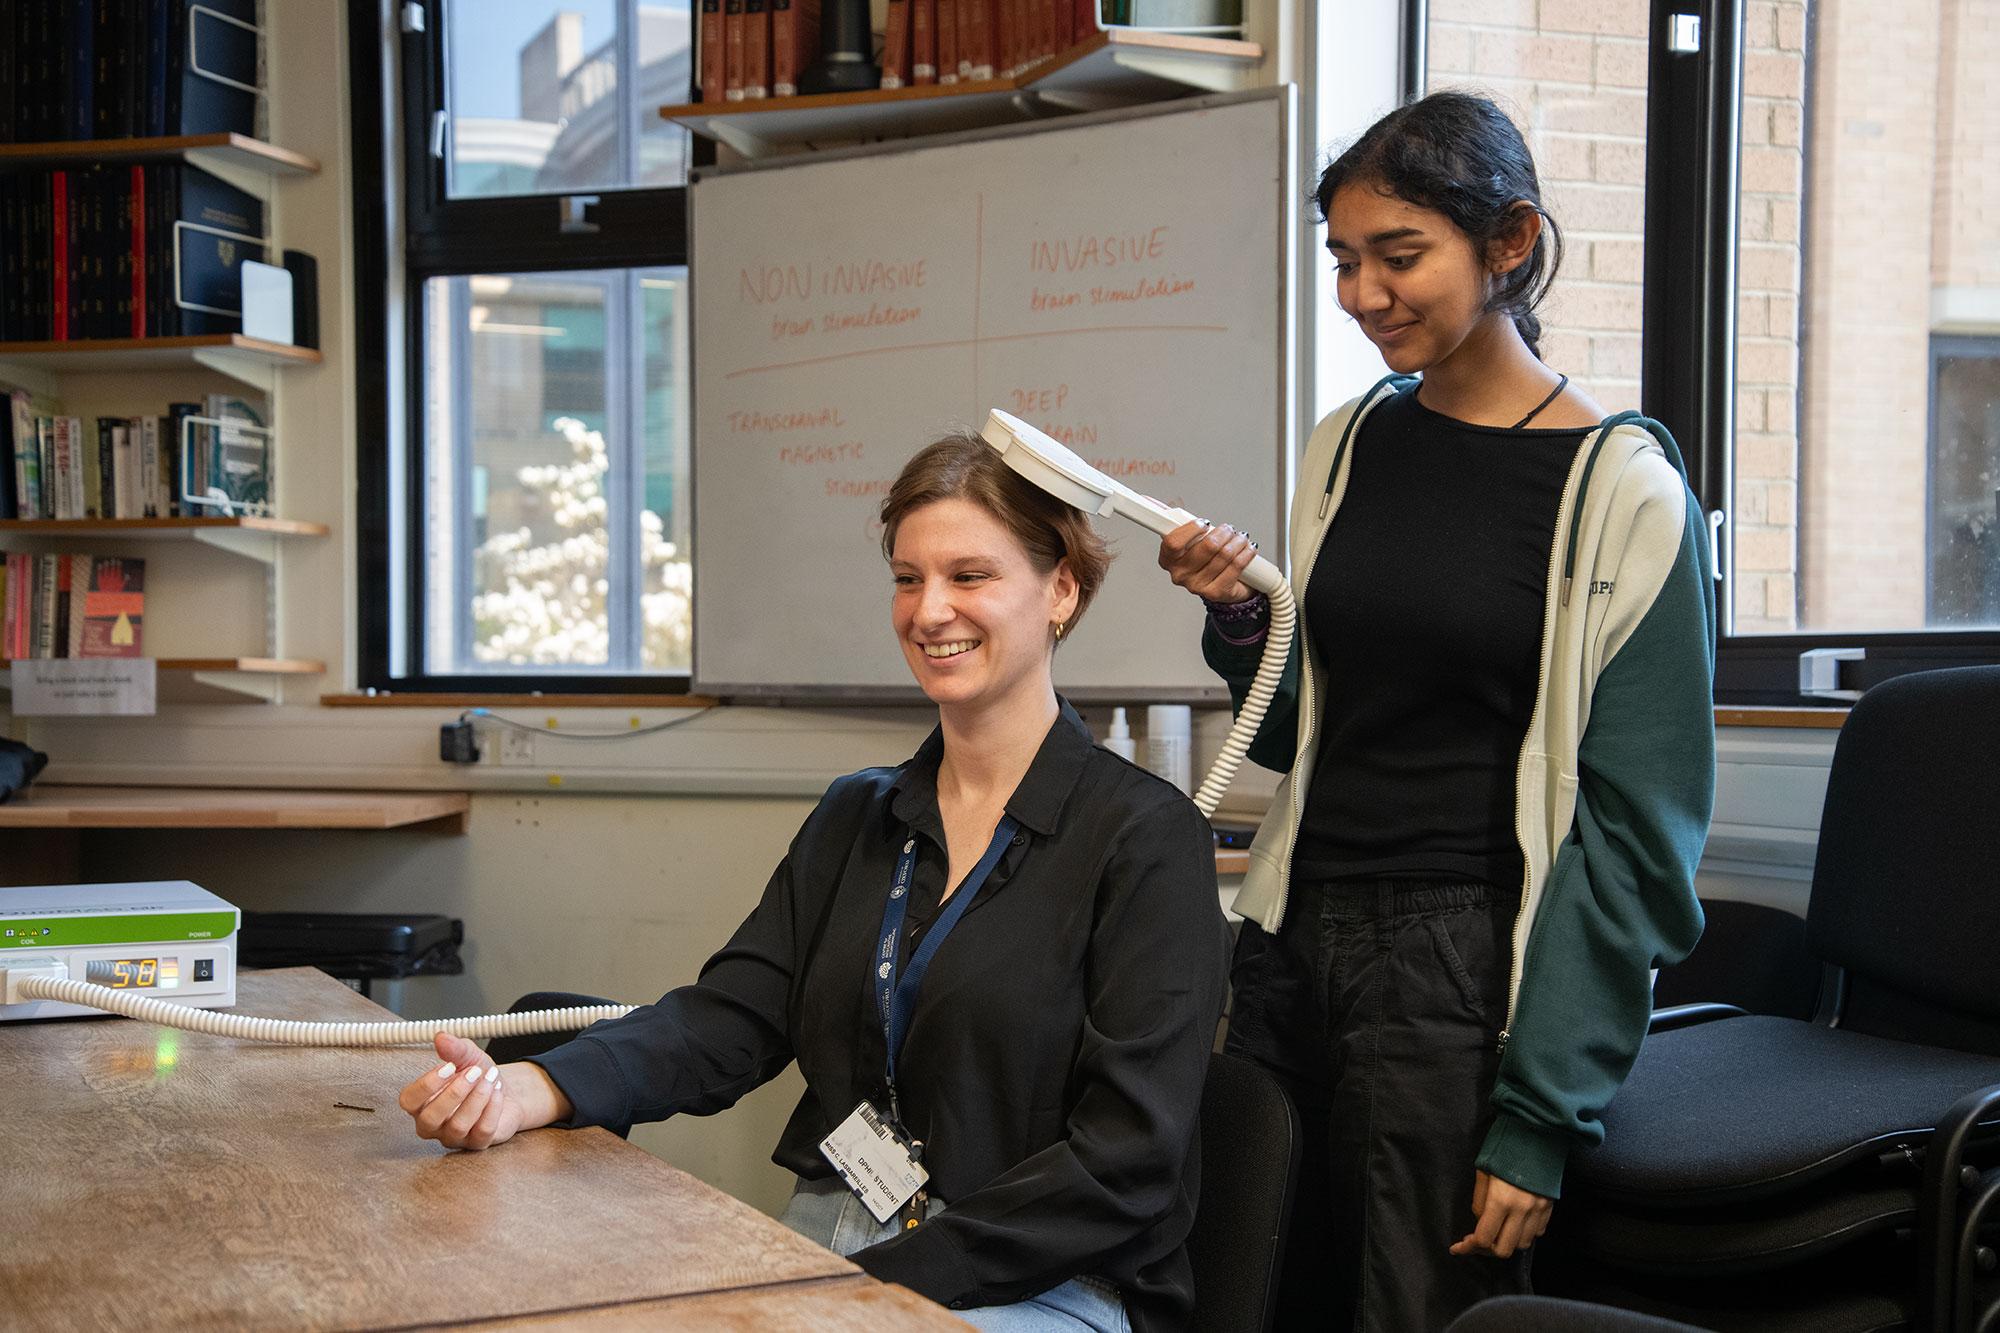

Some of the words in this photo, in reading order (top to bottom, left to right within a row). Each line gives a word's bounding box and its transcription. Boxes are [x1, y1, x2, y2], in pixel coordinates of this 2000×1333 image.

[1030, 225, 1170, 273] INVASIVE
[740, 262, 812, 303] NON
[873, 1175, 900, 1206] STUDENT
